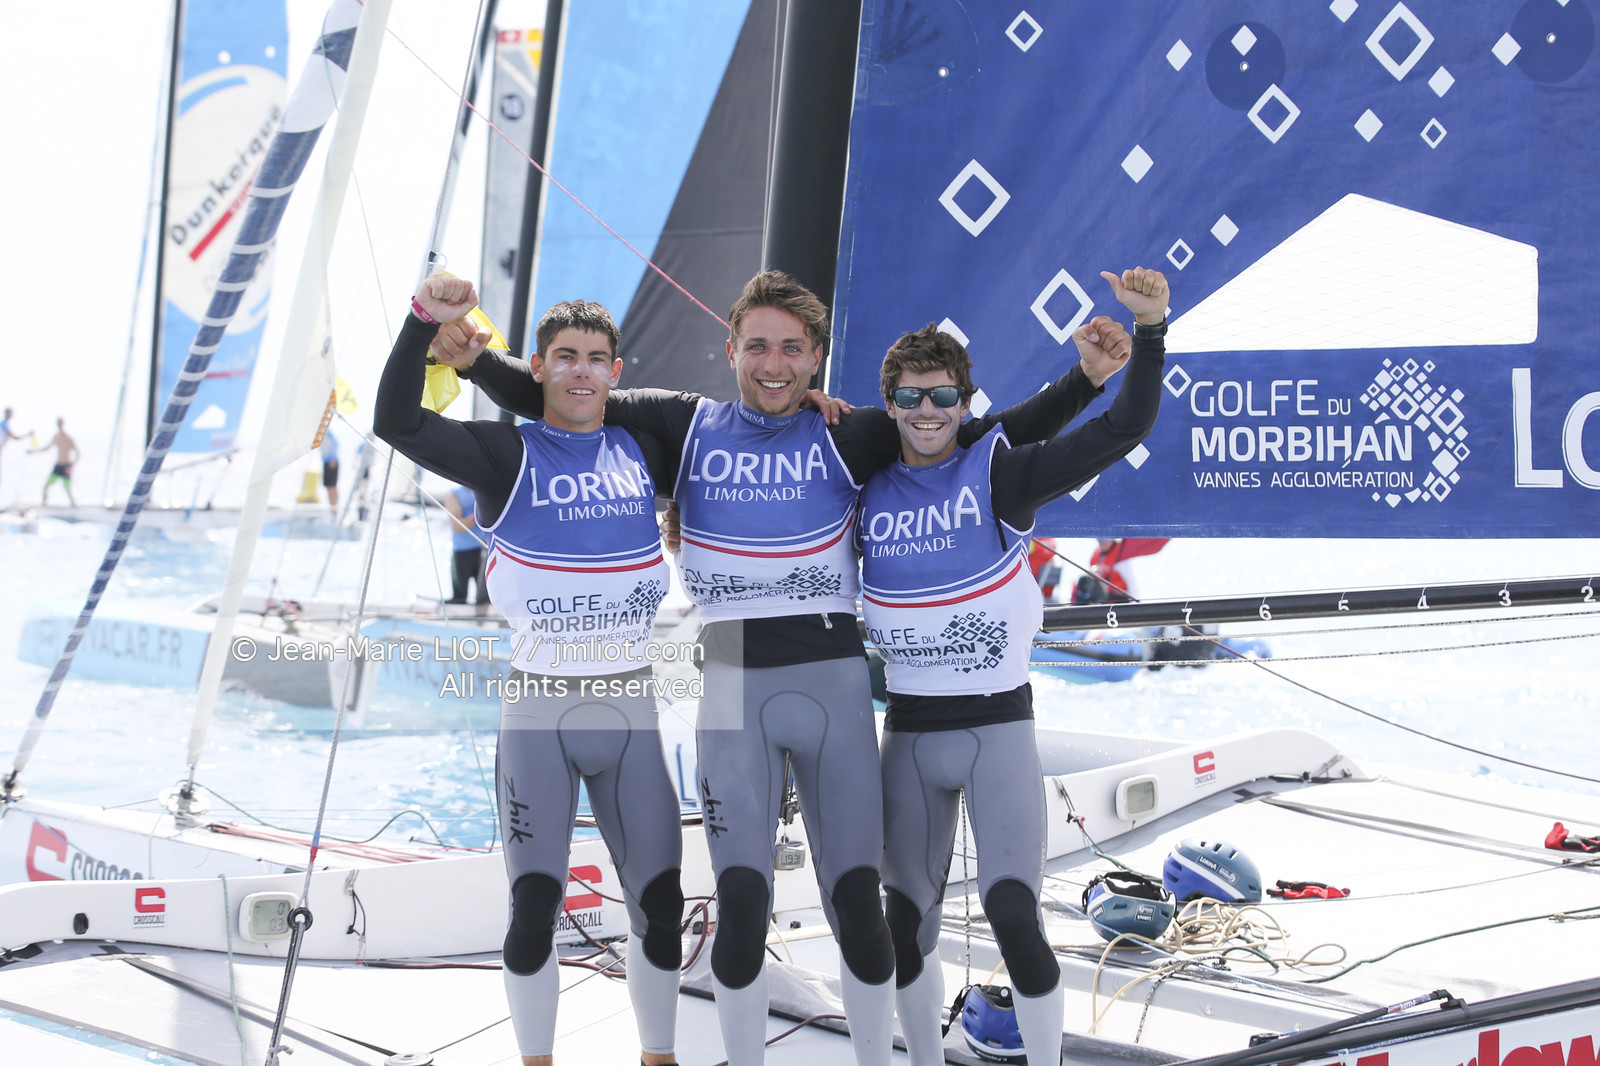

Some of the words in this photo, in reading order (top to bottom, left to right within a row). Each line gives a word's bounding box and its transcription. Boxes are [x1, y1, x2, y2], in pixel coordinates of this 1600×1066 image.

[170, 103, 281, 246] Dunkerque
[1190, 379, 1319, 417] GOLFE
[1328, 398, 1351, 415] DU
[688, 442, 828, 484] LORINA
[1193, 472, 1261, 488] VANNES
[1270, 462, 1413, 488] AGGLOMÉRATION
[530, 461, 654, 507] LORINA
[704, 485, 807, 502] LIMONADE
[558, 501, 645, 522] LIMONADE
[861, 485, 982, 542] LORINA
[871, 534, 957, 558] LIMONADE
[526, 593, 603, 615] GOLFE
[606, 601, 620, 610] DU
[1106, 611, 1119, 628] 8
[1182, 608, 1193, 625] 7
[1258, 604, 1273, 621] 6
[1337, 599, 1350, 611] 5
[1416, 596, 1430, 610] 4
[1498, 589, 1512, 607] 3
[1580, 585, 1596, 603] 2
[921, 635, 936, 644] DU
[133, 915, 165, 925] CROSSCALL
[556, 910, 603, 932] ROSSCALL
